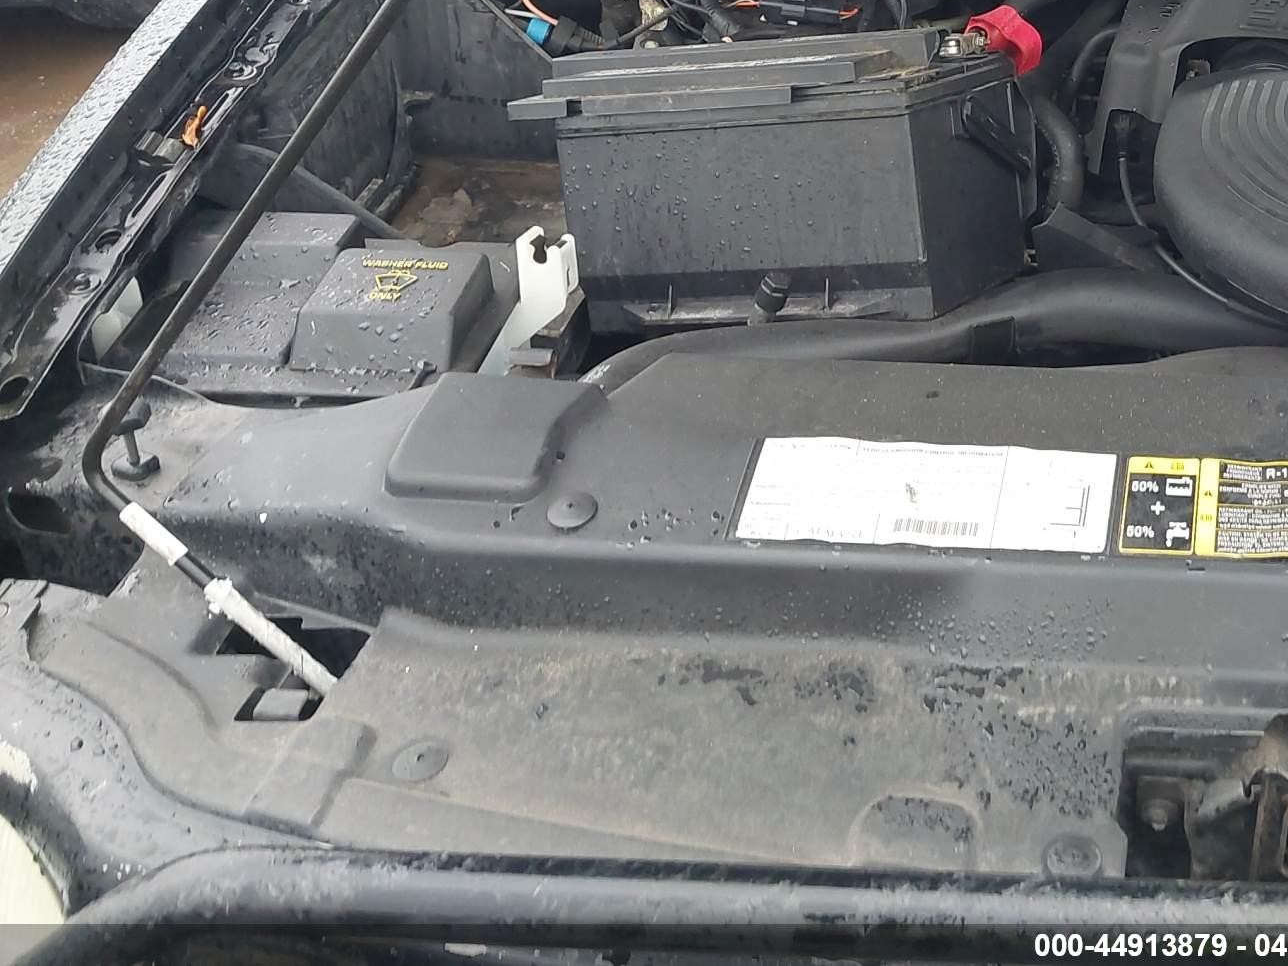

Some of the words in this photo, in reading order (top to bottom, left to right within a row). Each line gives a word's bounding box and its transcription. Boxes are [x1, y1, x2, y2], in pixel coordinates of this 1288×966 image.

[362, 259, 412, 268] WASHER
[415, 261, 449, 270] FLUID
[369, 292, 402, 302] ONLY
